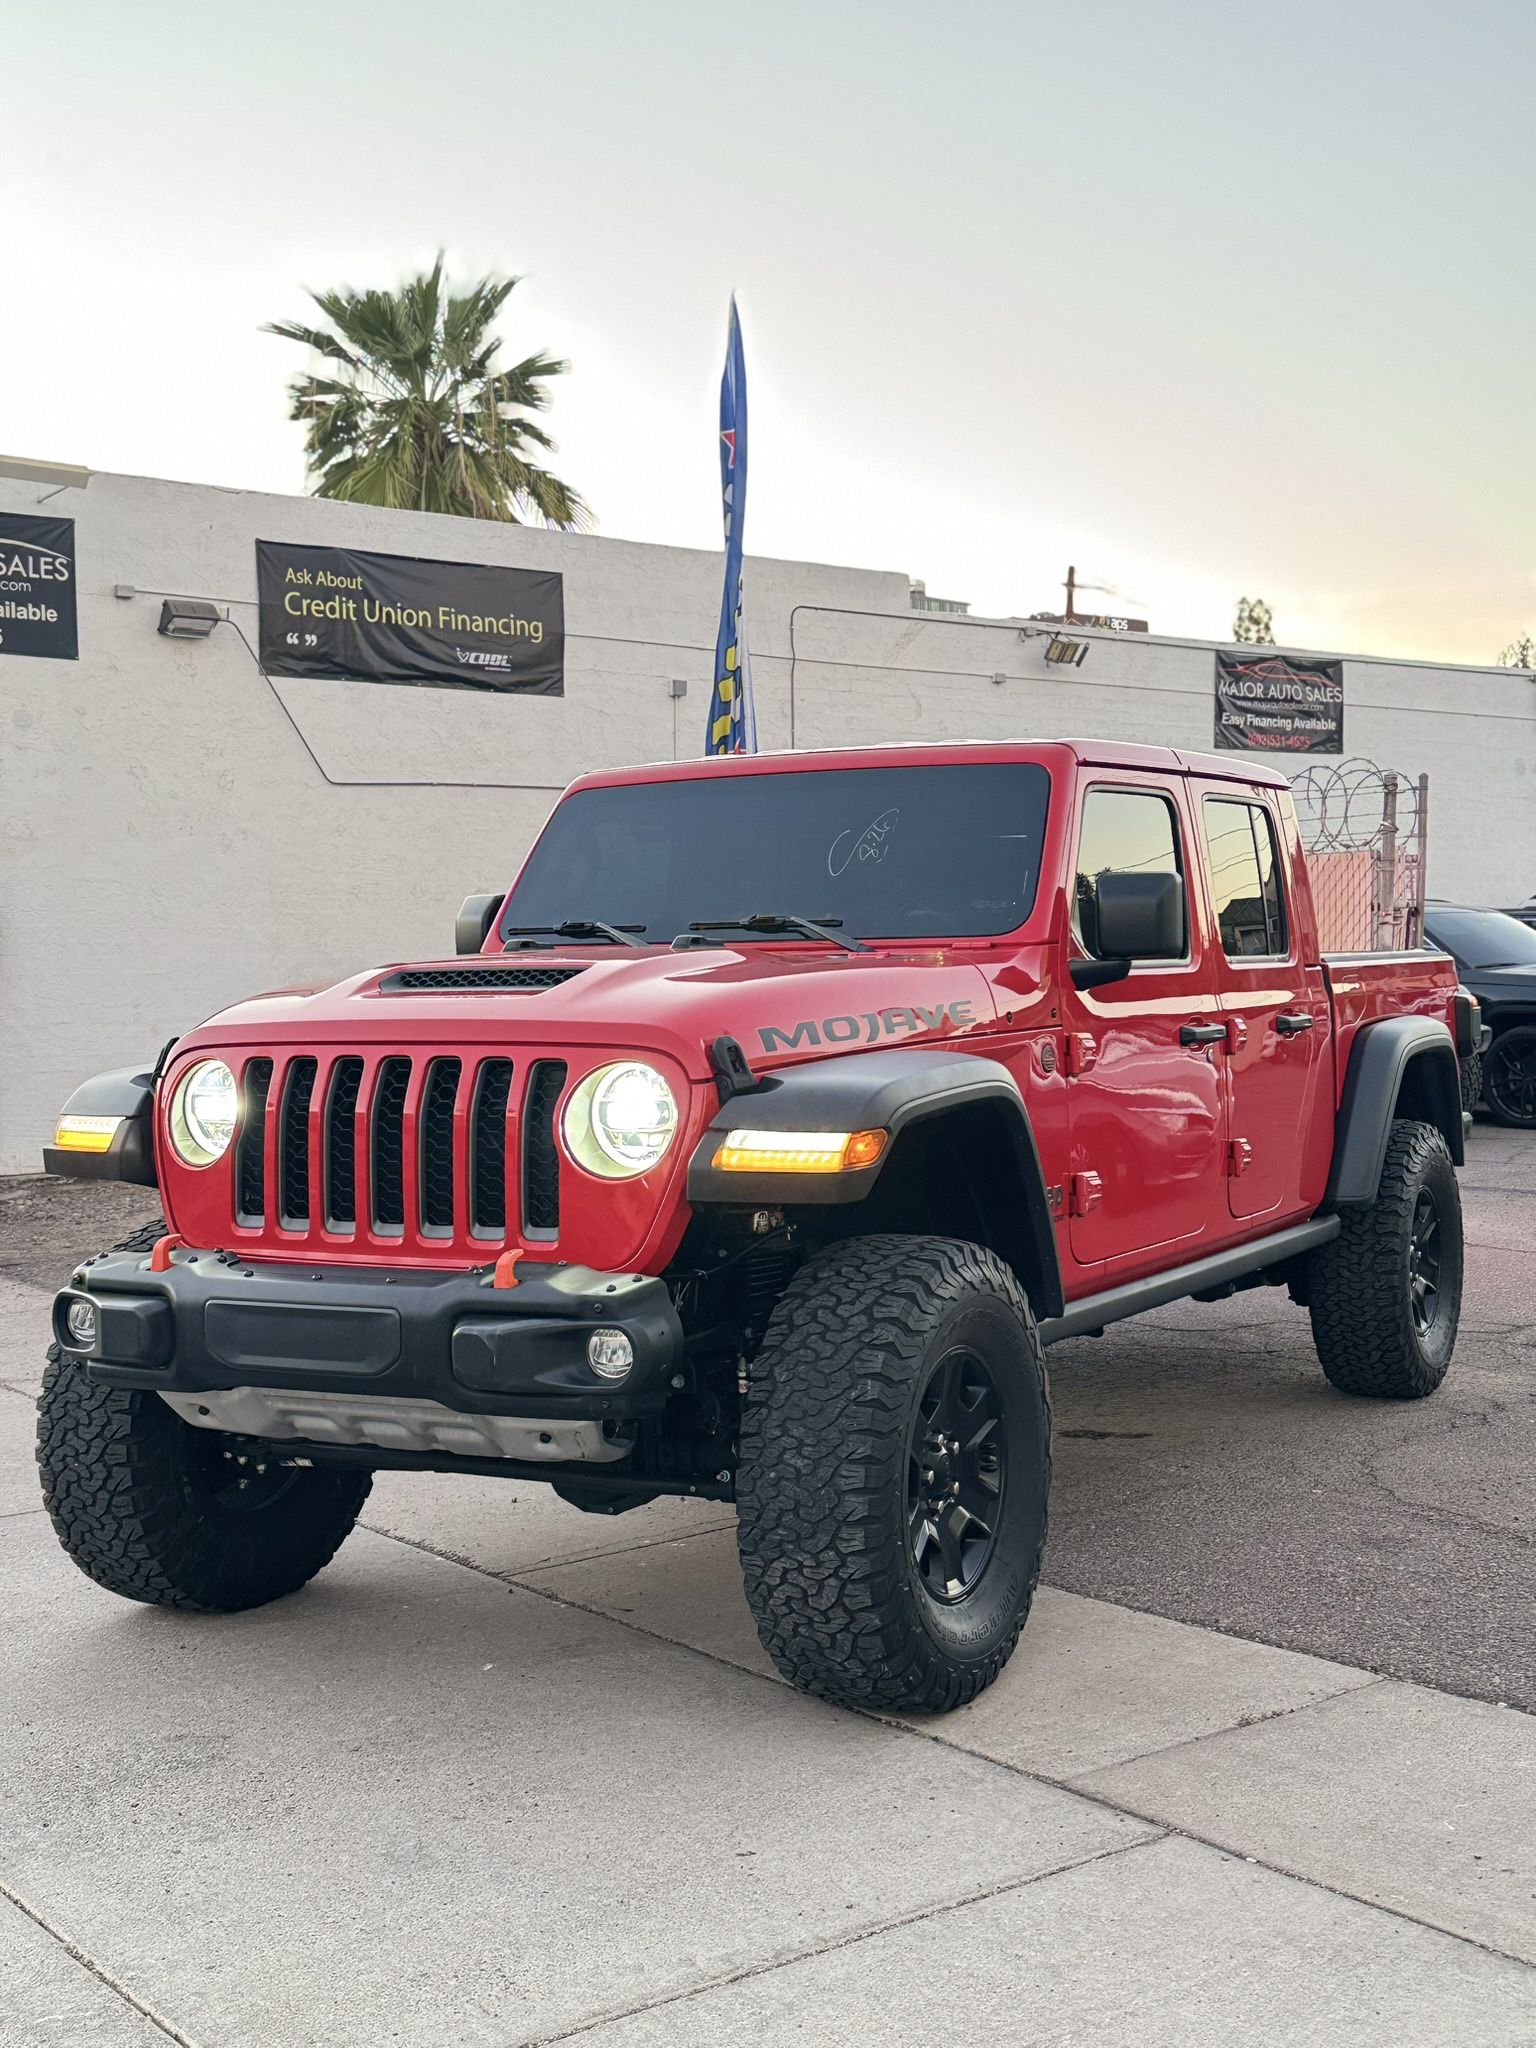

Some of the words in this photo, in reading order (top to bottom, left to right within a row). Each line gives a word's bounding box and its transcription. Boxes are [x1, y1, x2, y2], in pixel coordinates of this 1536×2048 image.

[285, 567, 313, 585] Ask
[316, 570, 363, 590] About
[284, 591, 357, 621] Credit
[363, 598, 432, 628] Union
[438, 606, 543, 643] Financing
[1111, 618, 1128, 632] aps
[1219, 679, 1264, 698] MAJOR
[1268, 684, 1303, 700] AUTO
[1305, 686, 1343, 703] SALES
[1222, 712, 1245, 728] Easy
[1246, 714, 1292, 731] Financing
[1293, 717, 1336, 731] Available
[757, 1000, 977, 1053] MOJAVE
